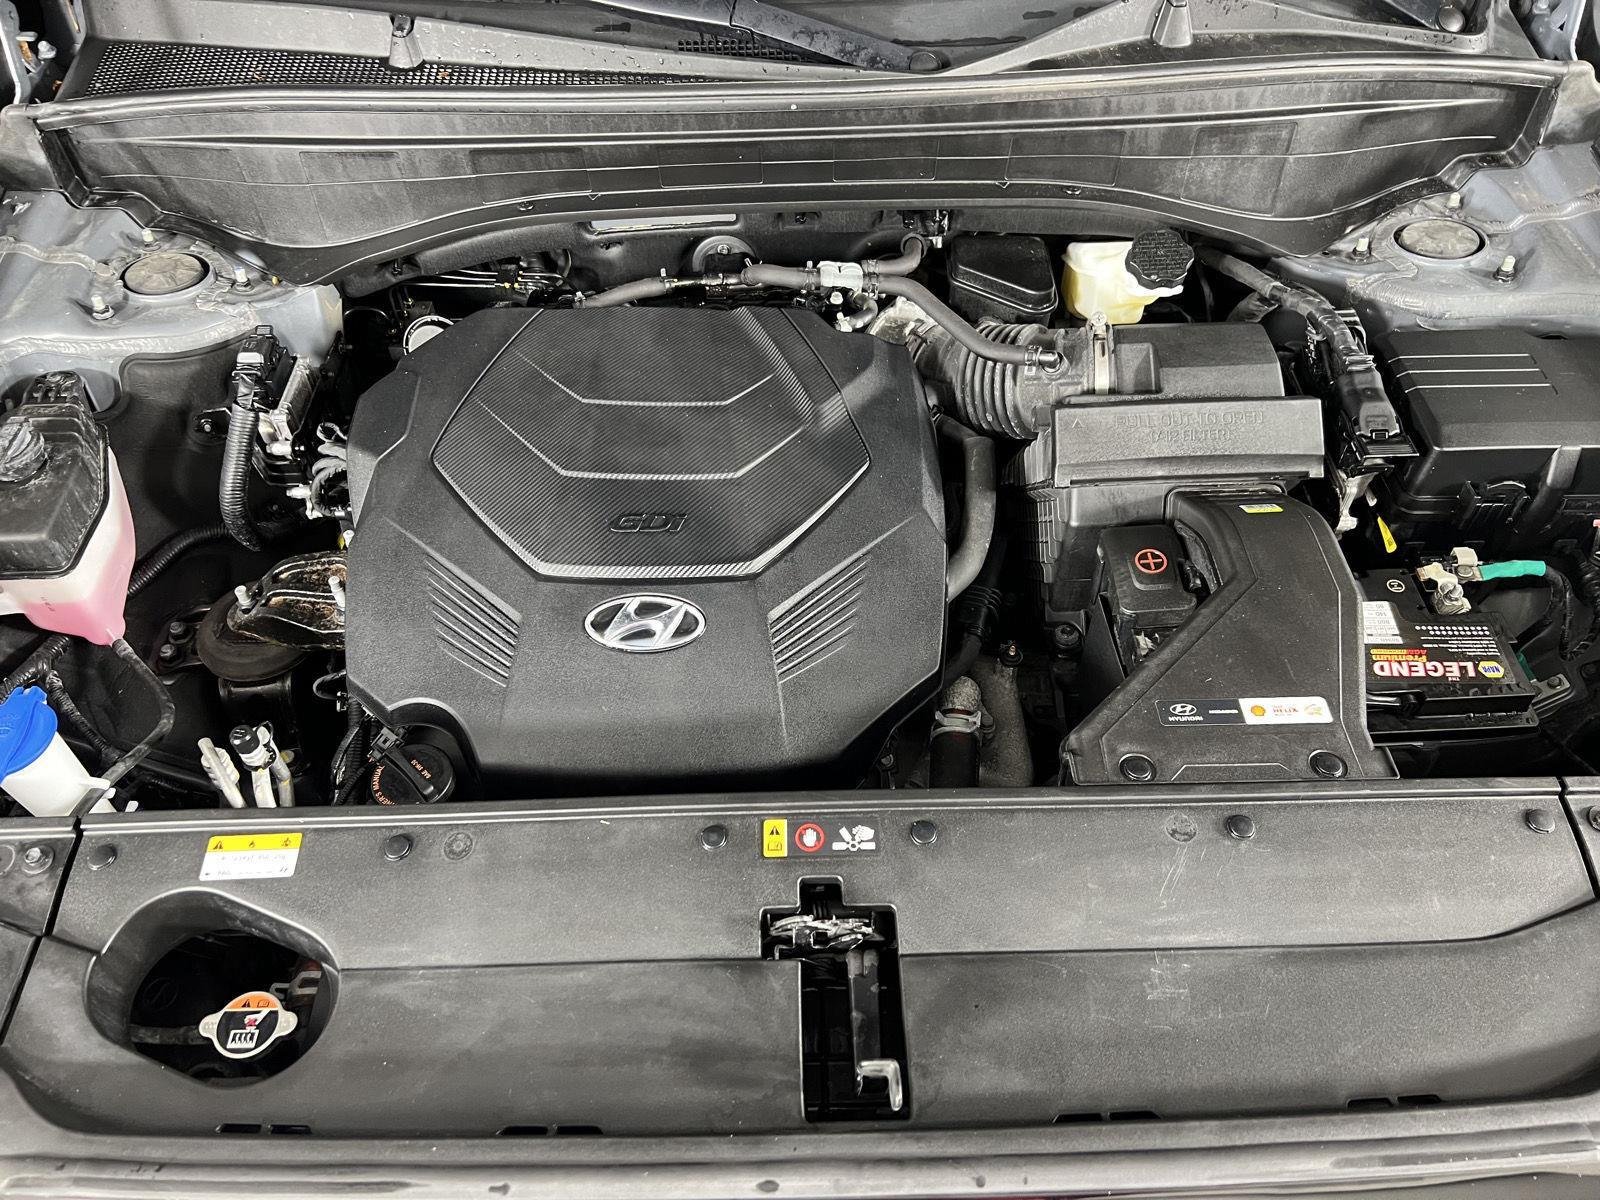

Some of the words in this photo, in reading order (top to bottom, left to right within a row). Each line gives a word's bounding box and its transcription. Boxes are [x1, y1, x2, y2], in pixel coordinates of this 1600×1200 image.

[1114, 413, 1156, 428] PULL
[1161, 410, 1191, 427] OUT
[1197, 410, 1217, 425] TO
[1220, 408, 1264, 425] OPEN
[1372, 654, 1428, 662] Premium
[1373, 661, 1476, 677] LEGEND
[1481, 665, 1501, 674] NAPA
[372, 765, 386, 791] MANUAL
